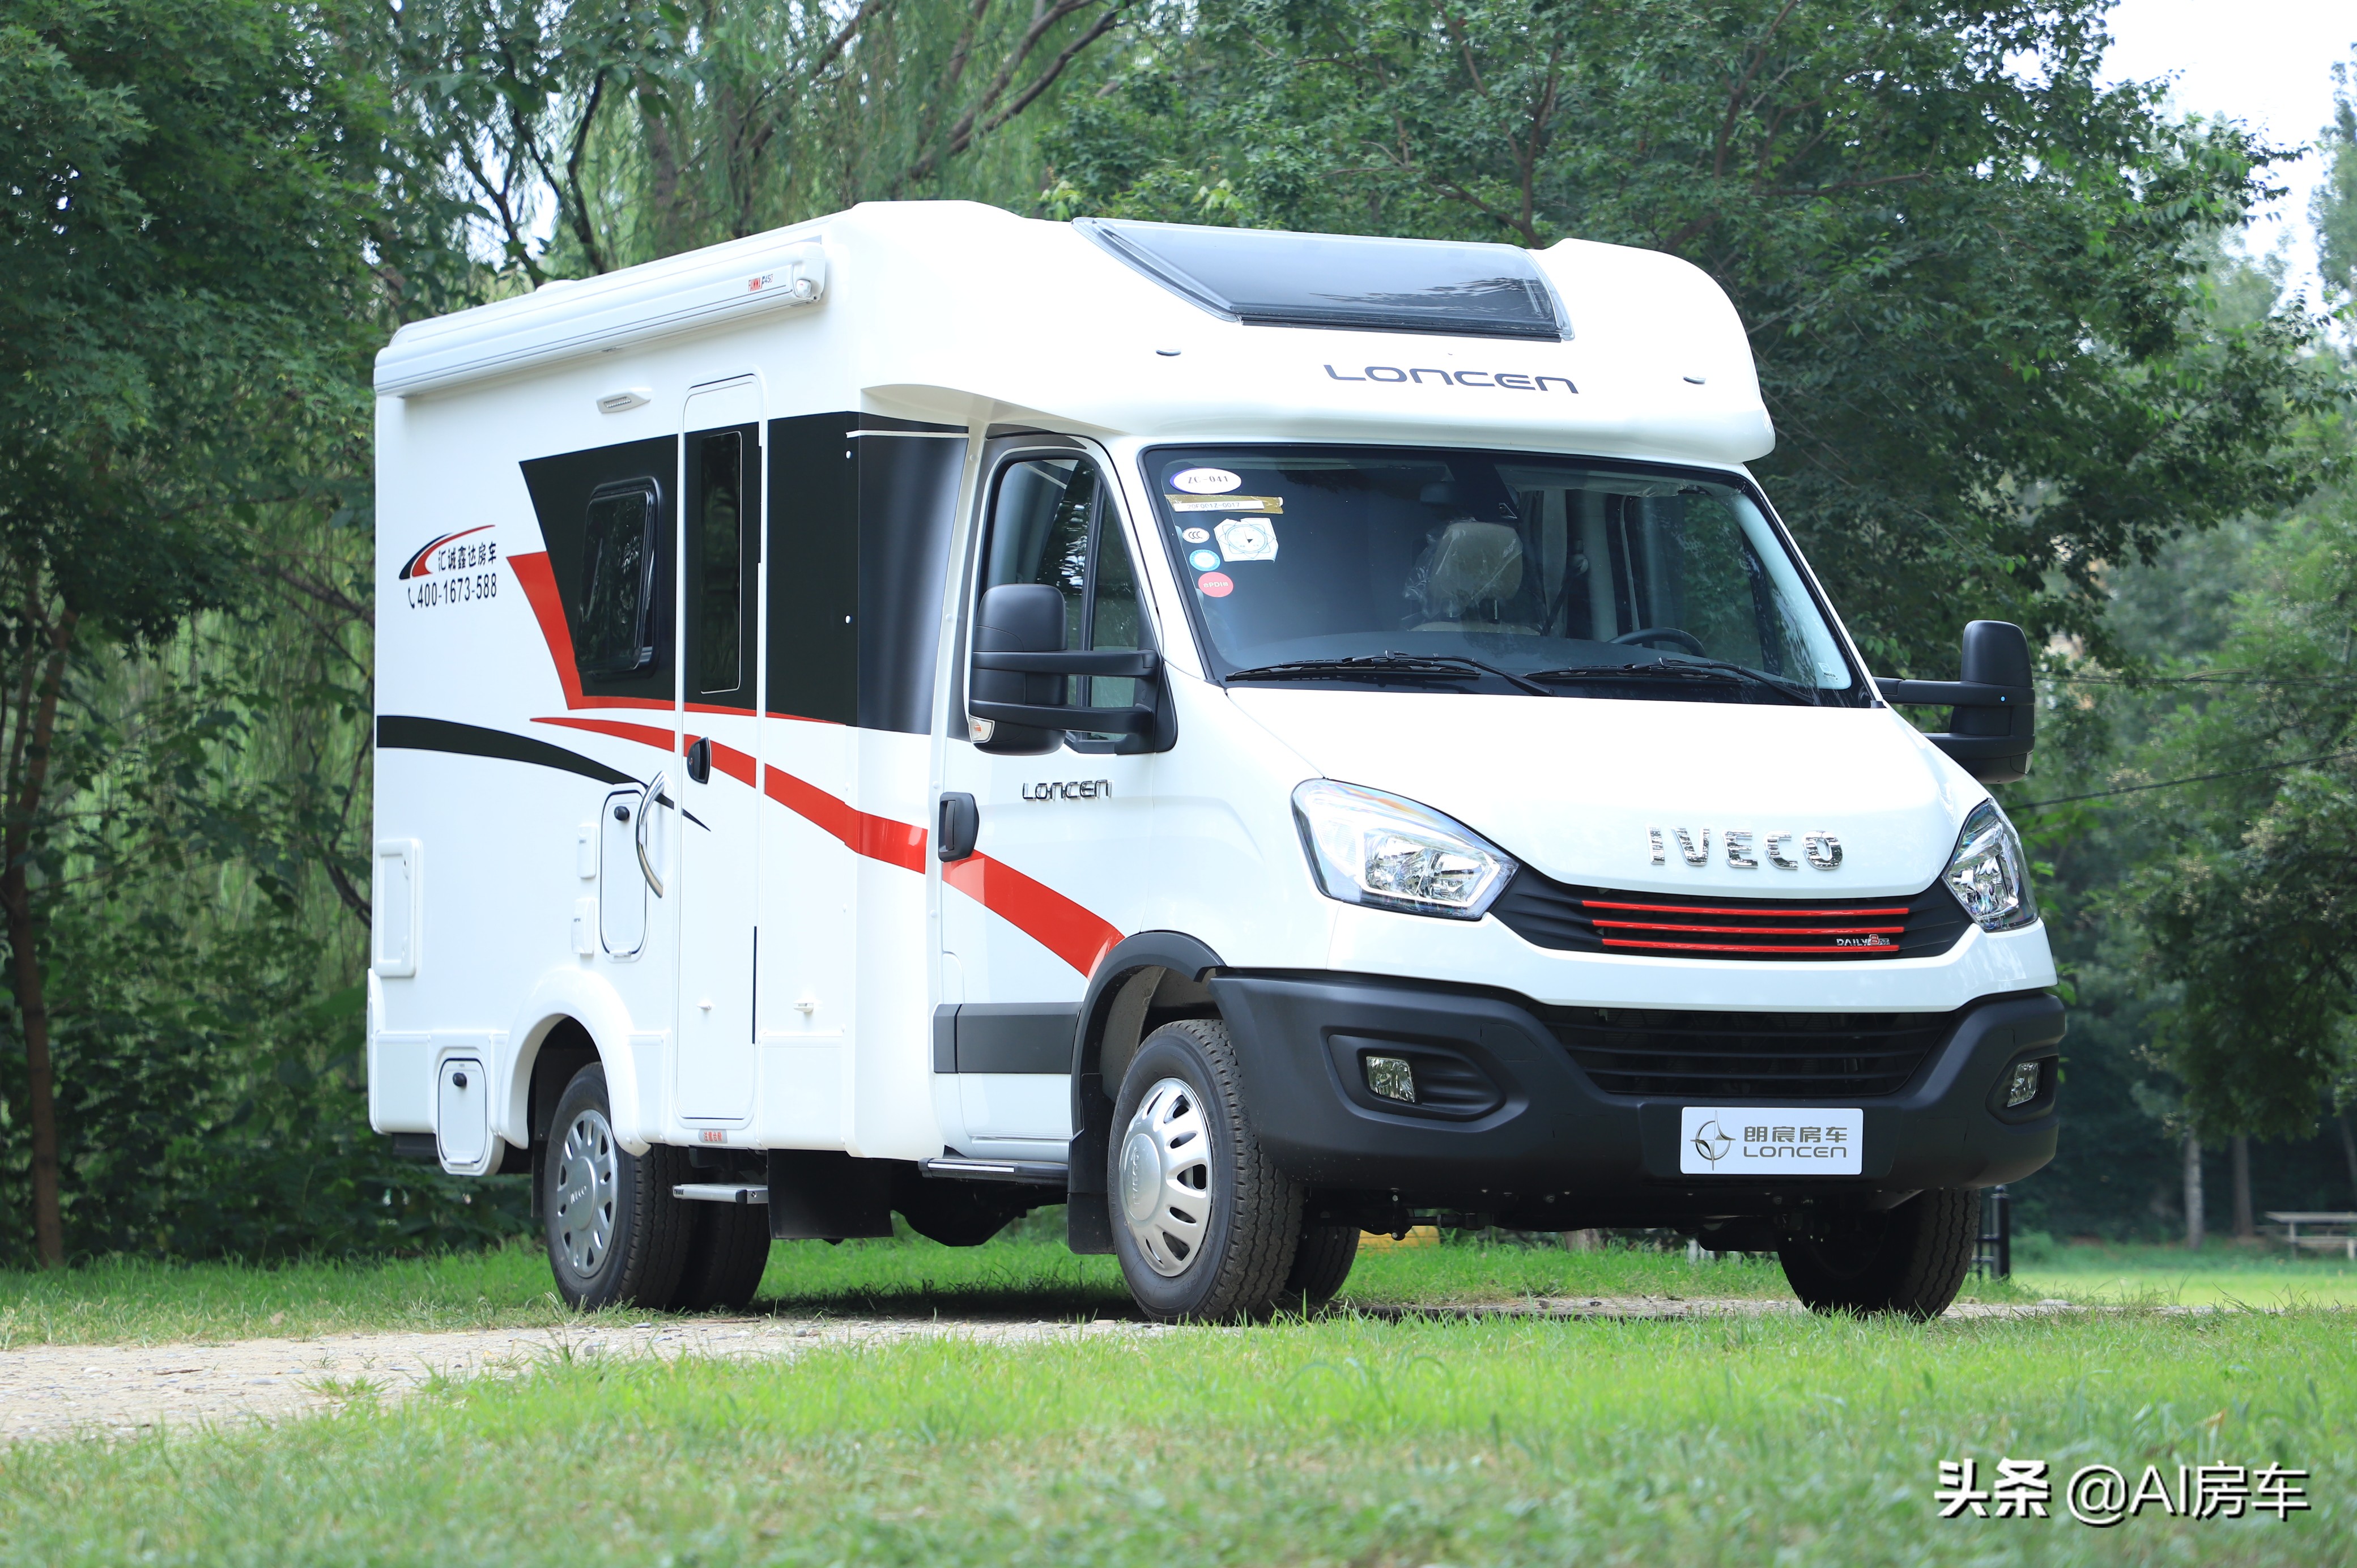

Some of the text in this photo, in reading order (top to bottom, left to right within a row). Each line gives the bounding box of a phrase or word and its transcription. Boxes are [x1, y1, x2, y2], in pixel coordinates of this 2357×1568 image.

[1323, 364, 1579, 394] LONCEN
[438, 541, 496, 573] 汇诚鑫达房车
[417, 573, 497, 608] 400-1673-588
[1022, 779, 1113, 800] LONCEN
[1645, 825, 1843, 871] IVECO
[1743, 1146, 1847, 1158] LONCEN
